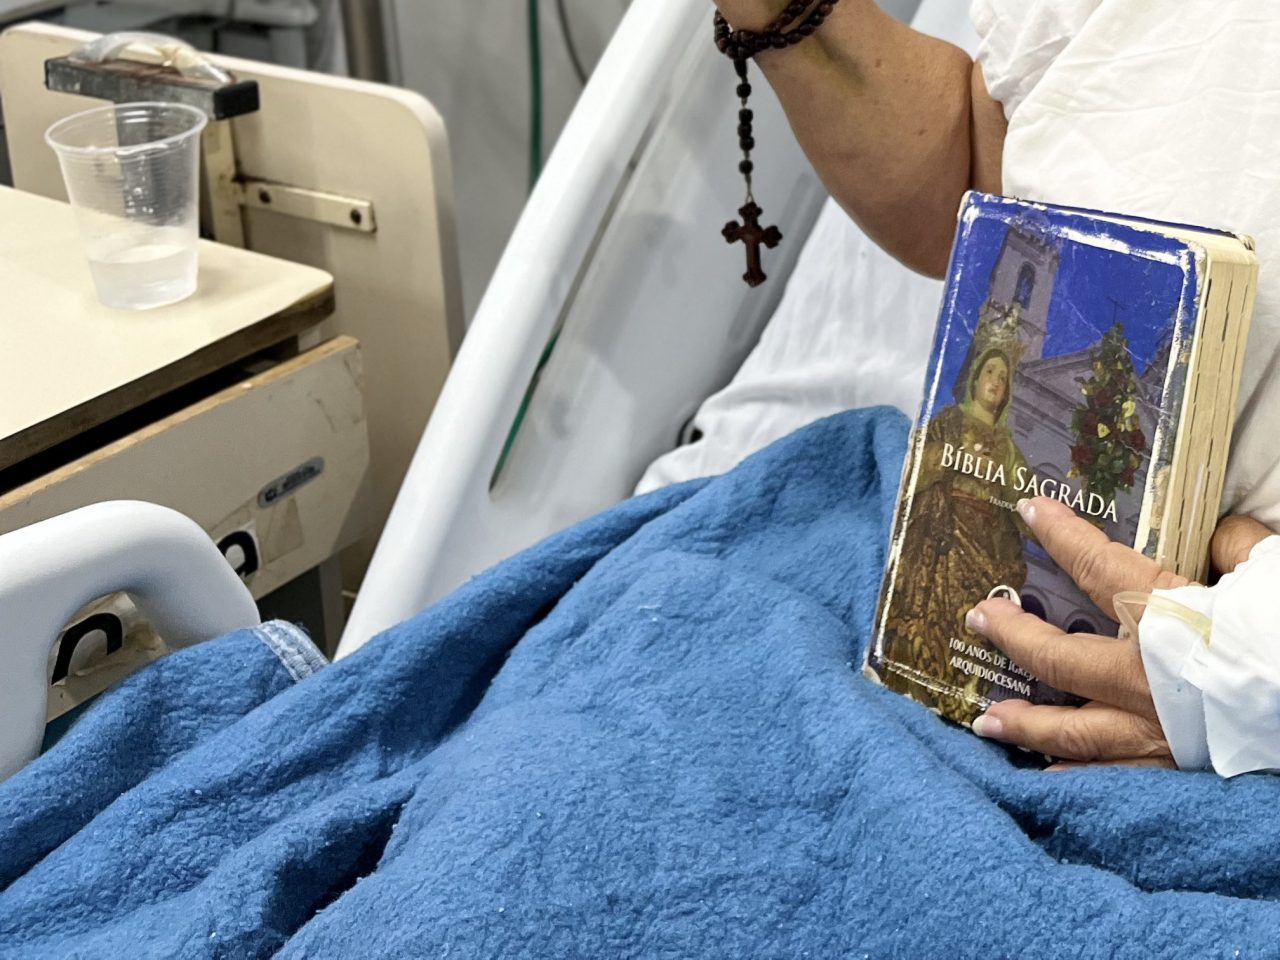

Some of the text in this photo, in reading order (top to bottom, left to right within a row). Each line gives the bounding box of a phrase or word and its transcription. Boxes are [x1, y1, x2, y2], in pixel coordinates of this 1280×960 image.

[940, 442, 1119, 523] BÍBLIA SAGRADA
[949, 637, 966, 653] 100
[965, 644, 992, 663] ANOS
[993, 653, 1007, 669] DE
[949, 655, 1032, 697] ARQUIDIOCESANA
